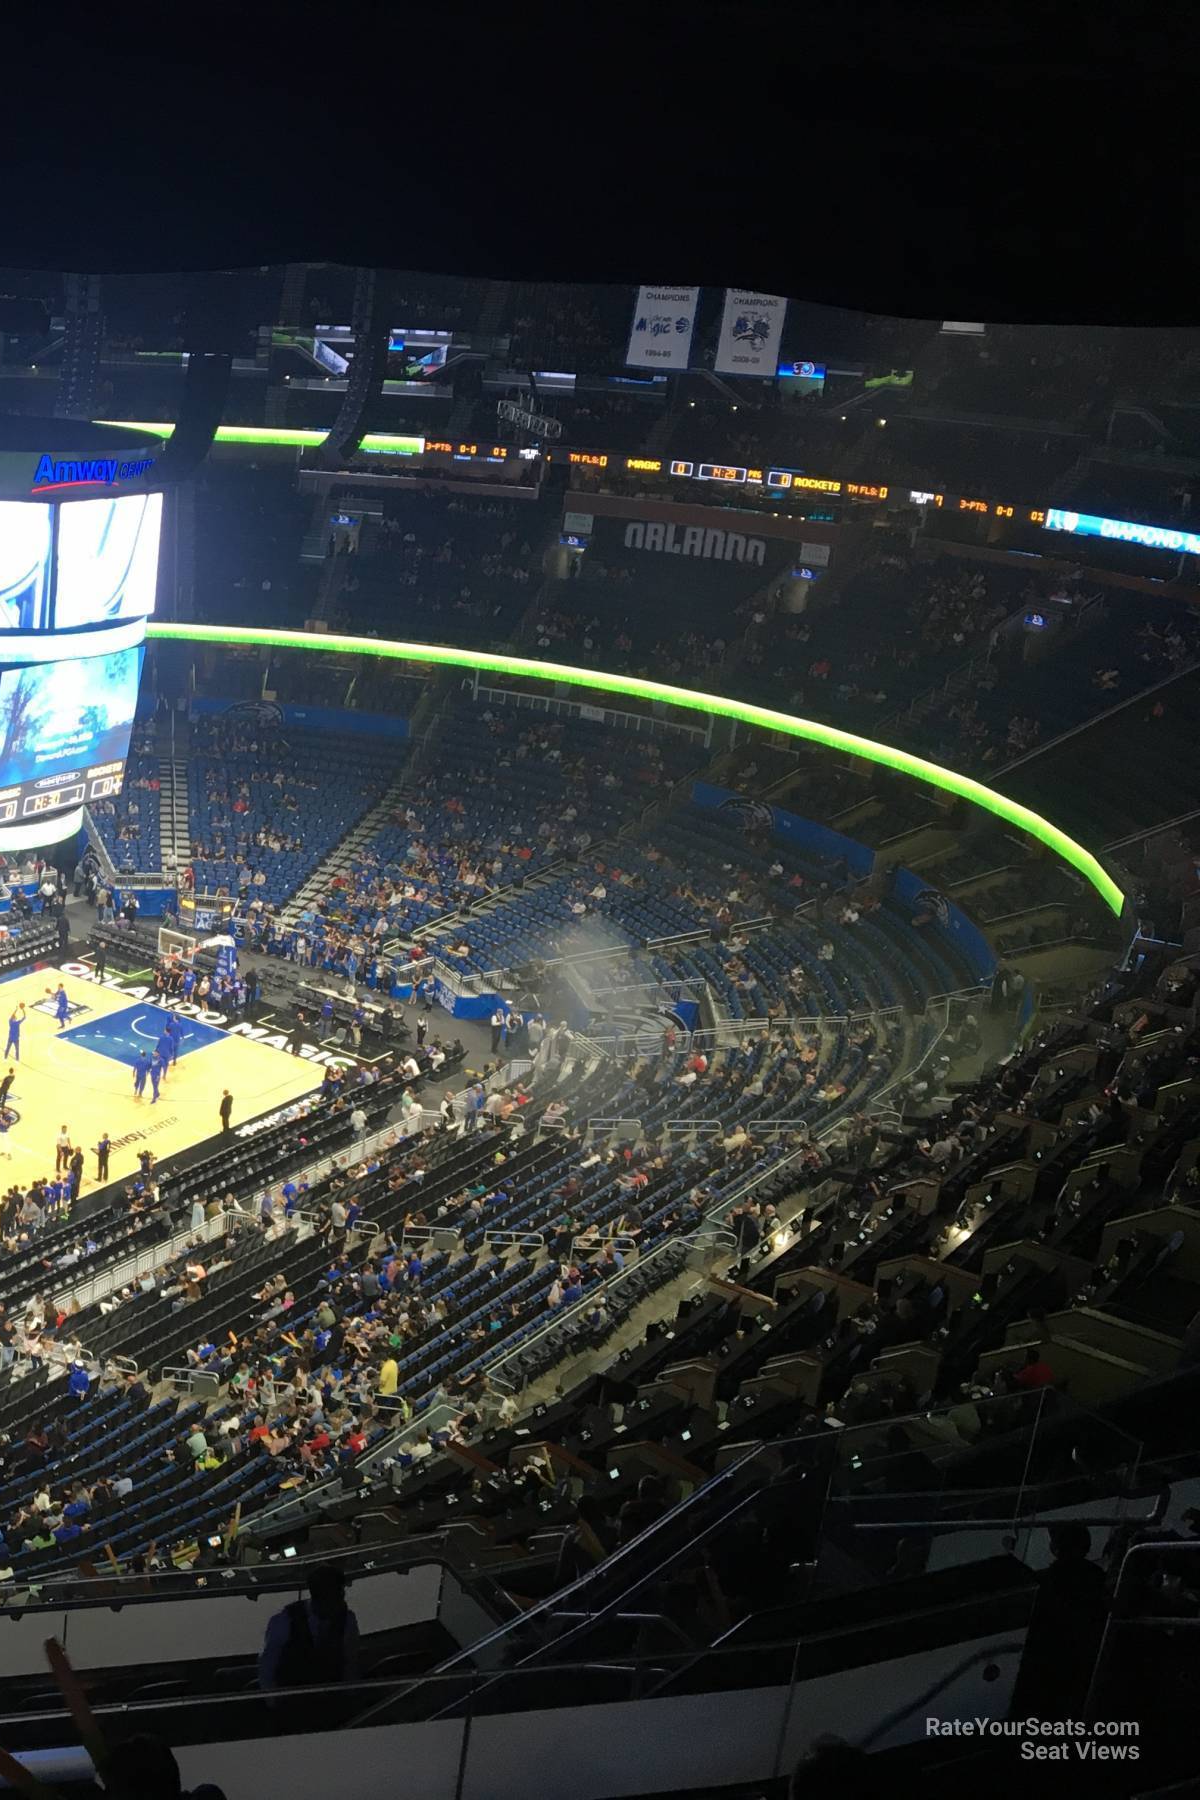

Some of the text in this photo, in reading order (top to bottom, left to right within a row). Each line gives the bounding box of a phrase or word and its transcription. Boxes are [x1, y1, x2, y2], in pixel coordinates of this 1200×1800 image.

[646, 292, 690, 302] CHAMPIONS
[733, 297, 779, 307] CHAMPIONS
[34, 454, 118, 486] Amway
[627, 458, 662, 472] MAGIC
[677, 463, 685, 475] 0
[780, 475, 790, 487] 0
[793, 476, 842, 493] ROCKETS
[1100, 518, 1183, 550] DIAMOND
[229, 1022, 358, 1070] MAGIC
[145, 1115, 179, 1136] CENTER
